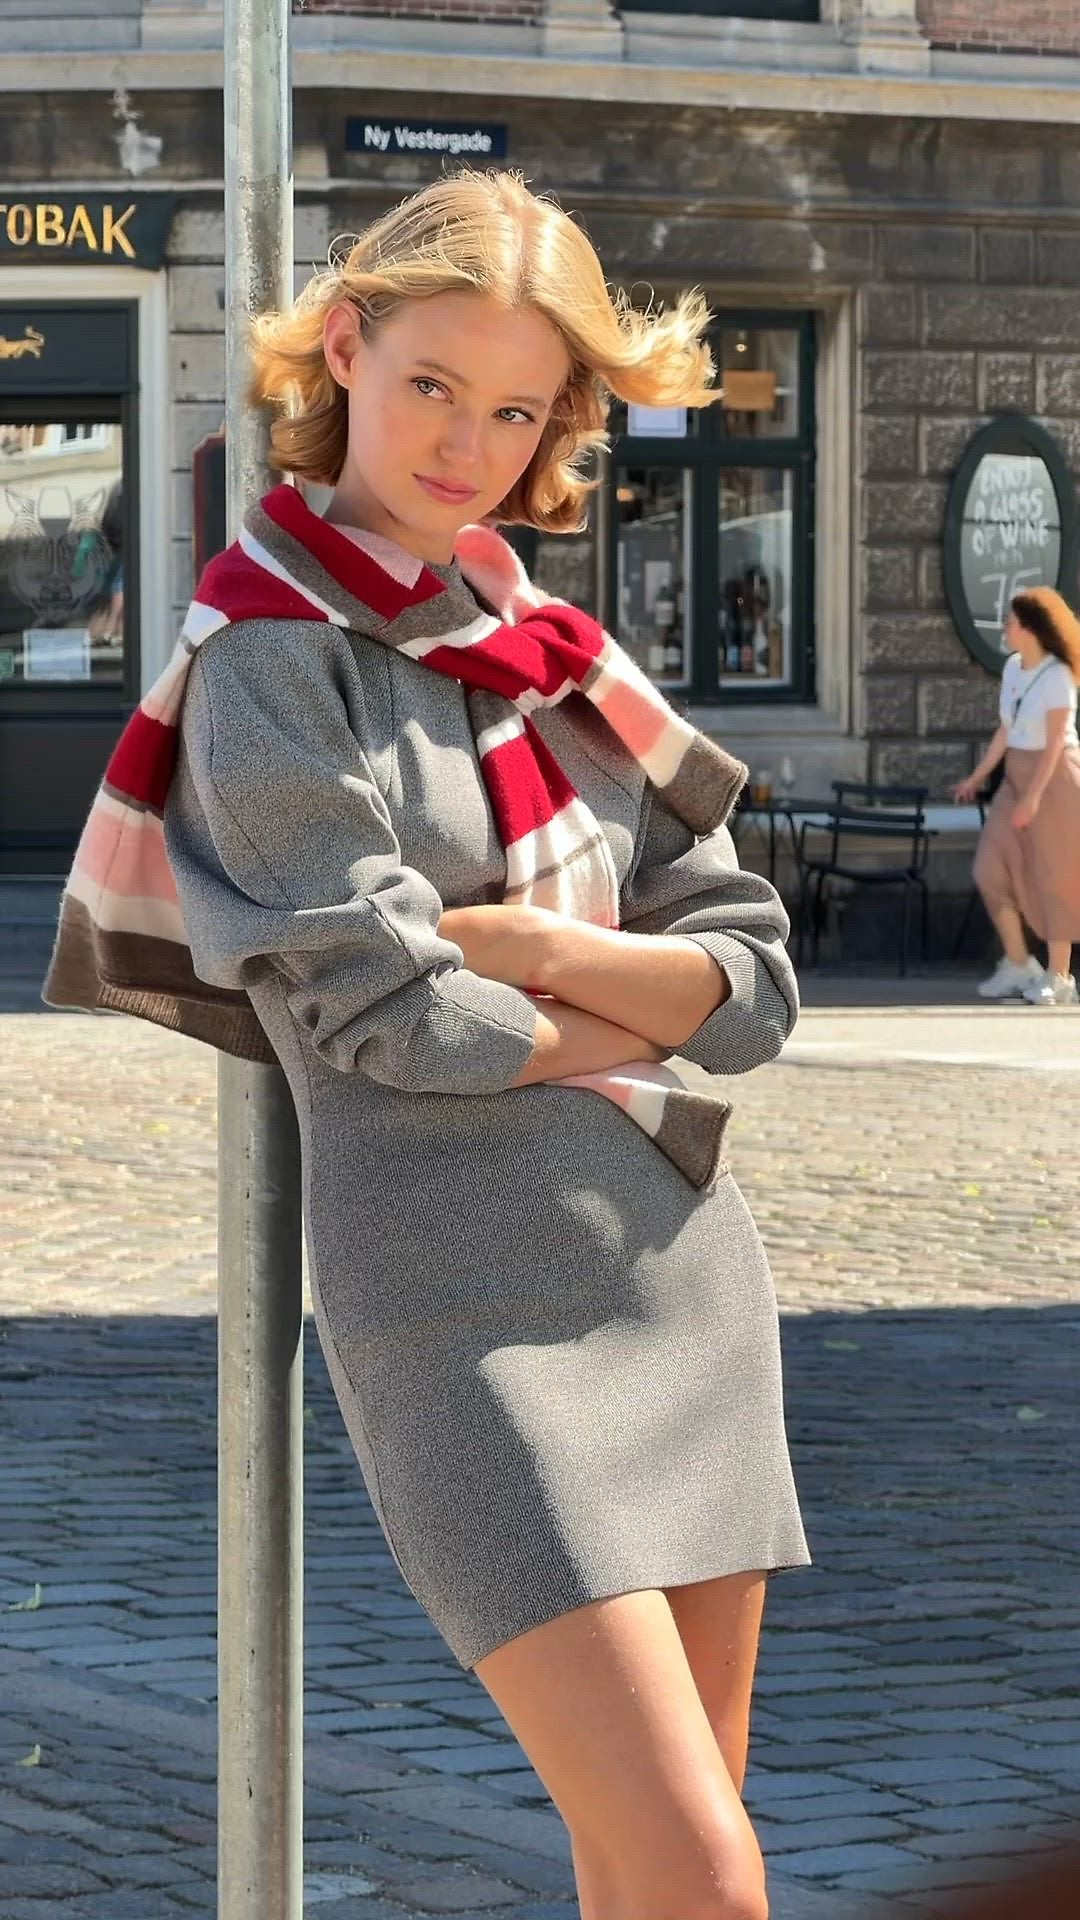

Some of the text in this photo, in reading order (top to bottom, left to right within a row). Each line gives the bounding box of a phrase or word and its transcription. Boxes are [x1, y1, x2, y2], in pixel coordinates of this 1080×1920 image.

[364, 124, 493, 154] Ny Vestergade
[991, 488, 1044, 521] GLASS
[1000, 519, 1050, 550] WINE
